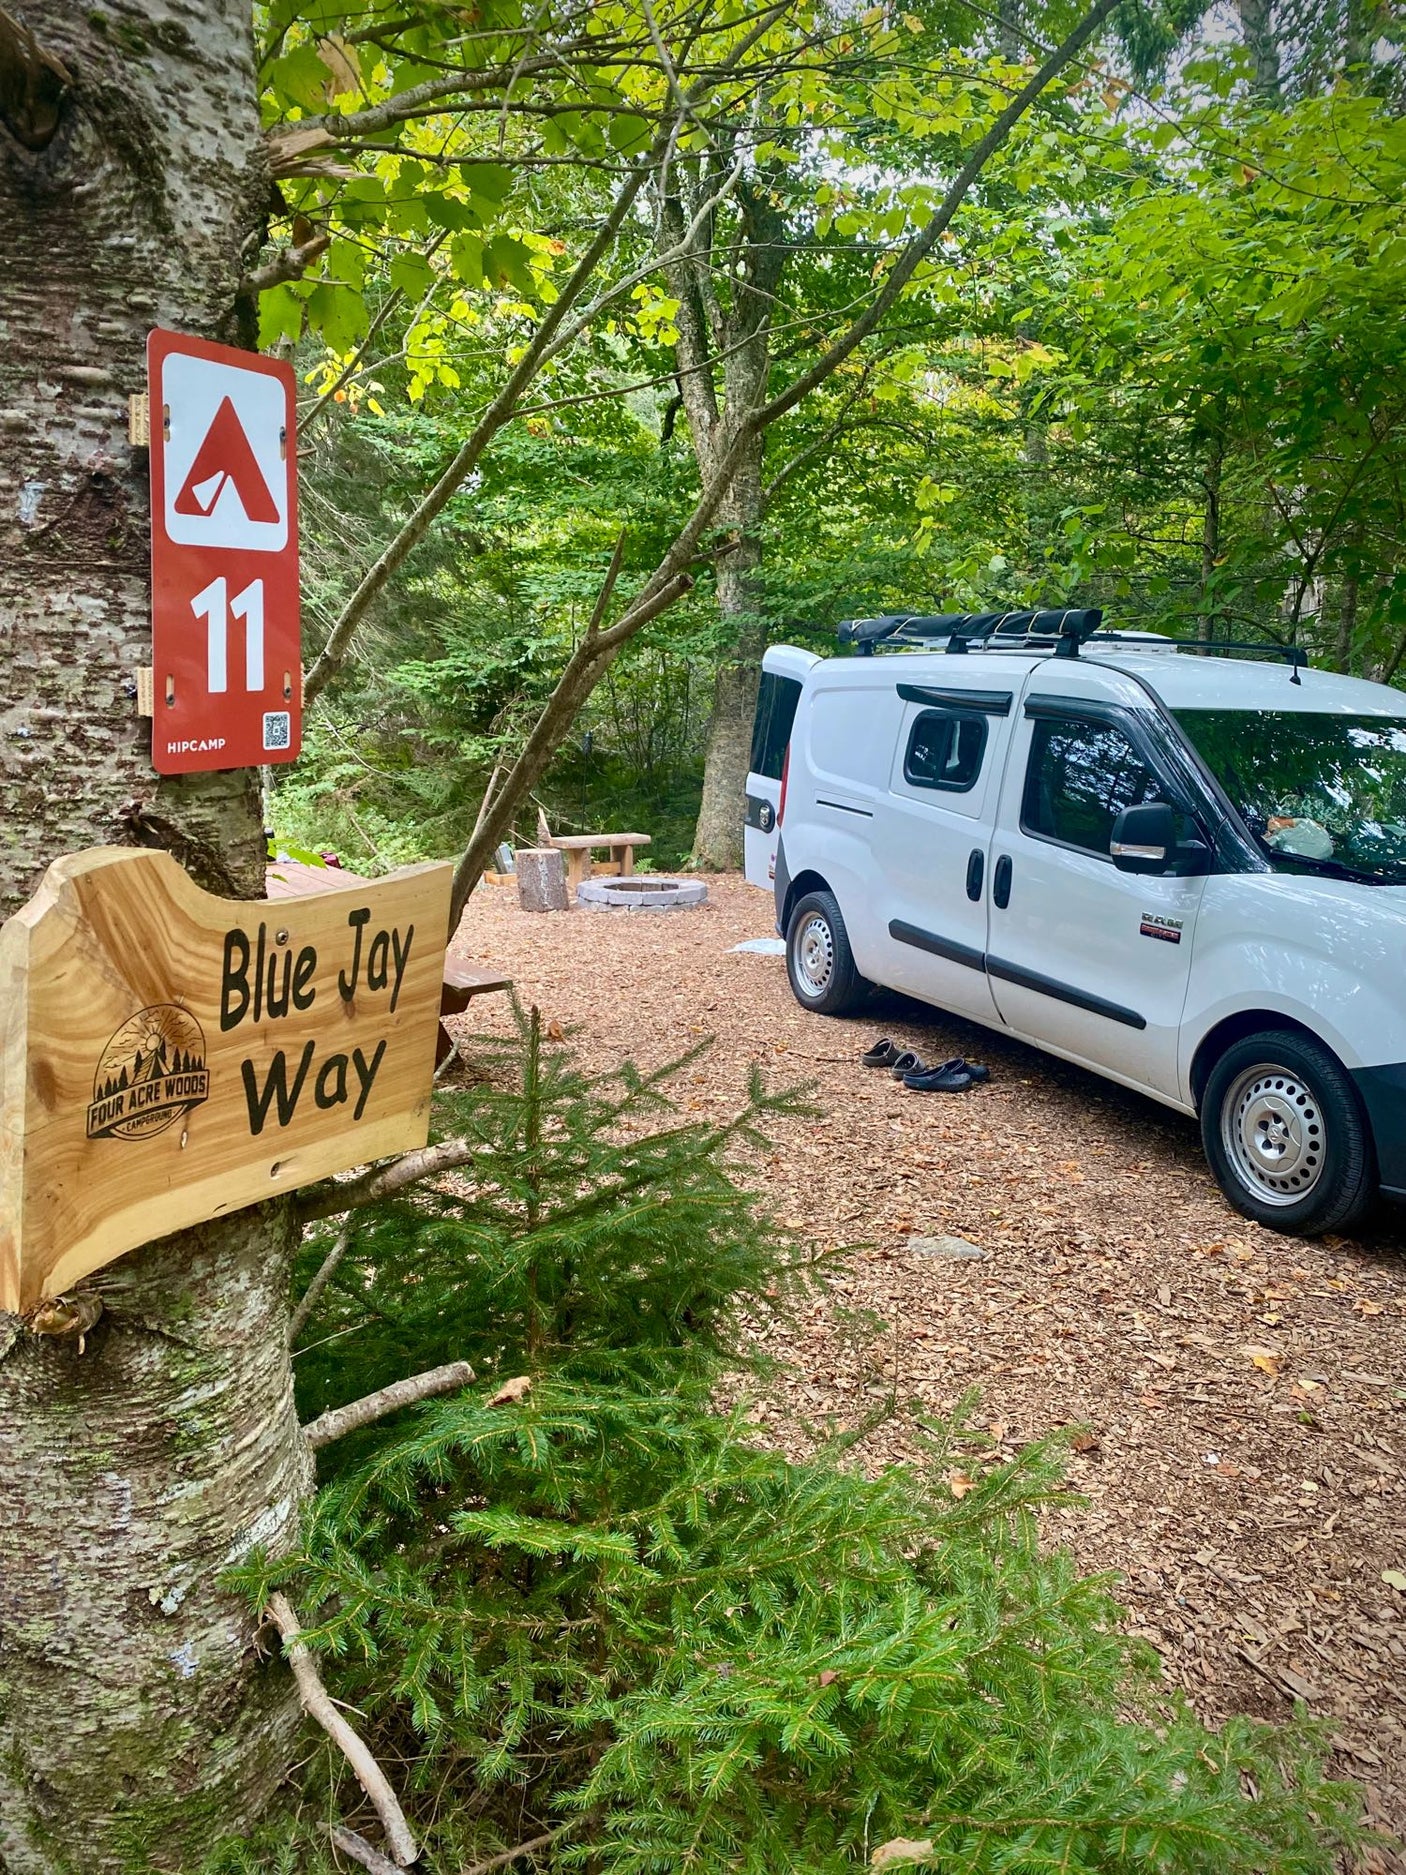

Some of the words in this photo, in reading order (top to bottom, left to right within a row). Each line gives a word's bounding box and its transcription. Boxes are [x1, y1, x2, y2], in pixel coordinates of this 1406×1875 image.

[190, 576, 264, 693] 11
[167, 738, 226, 754] HIPCAMP
[220, 922, 317, 1032] Blue
[338, 907, 414, 1014] Jay
[91, 1095, 125, 1130] FOUR
[128, 1081, 161, 1110] ACRE
[165, 1075, 206, 1098] WOODS
[126, 1109, 173, 1132] CAMPGROUND
[241, 1040, 387, 1136] Way
